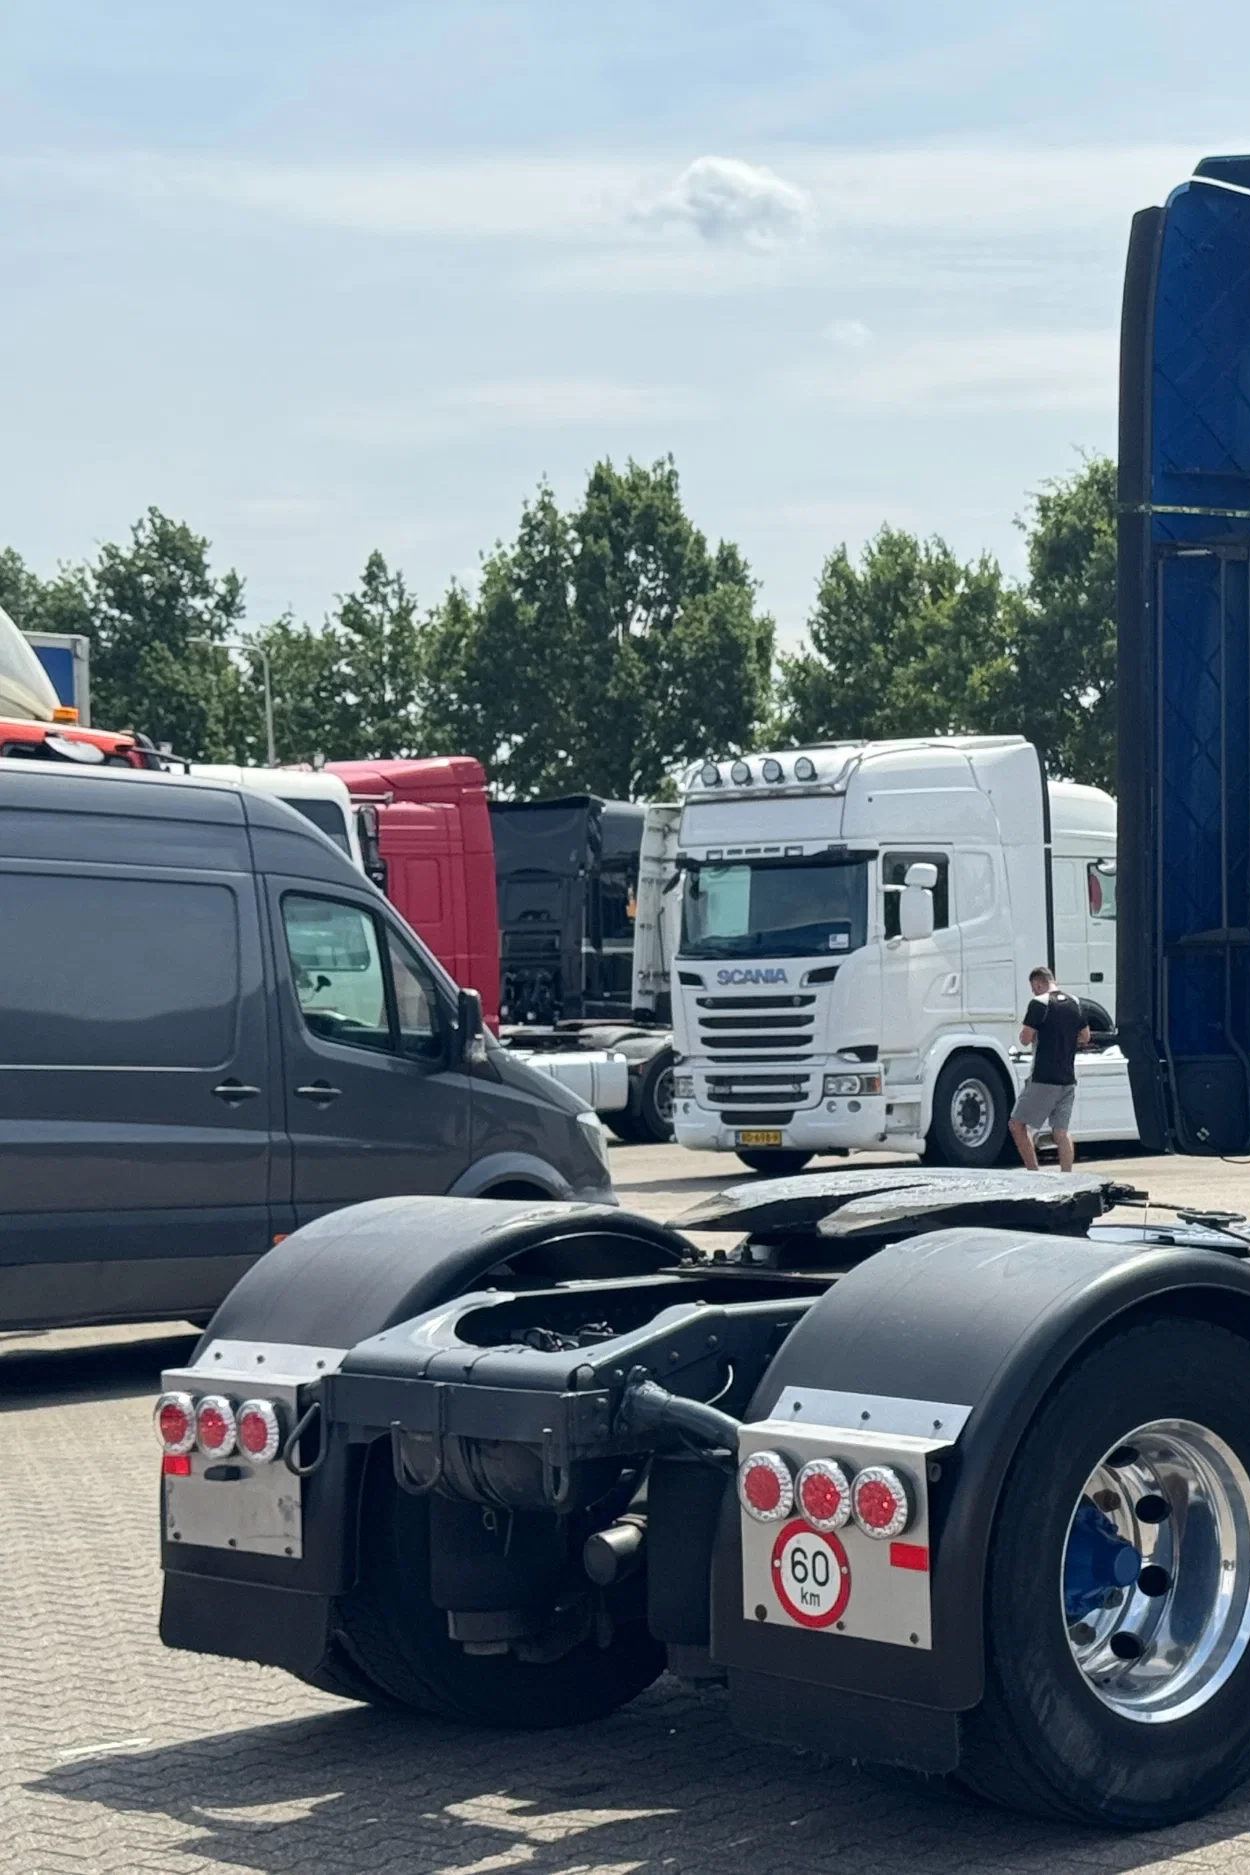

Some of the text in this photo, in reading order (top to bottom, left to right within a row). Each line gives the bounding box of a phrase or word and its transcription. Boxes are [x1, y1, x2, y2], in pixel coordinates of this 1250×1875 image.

[717, 968, 788, 985] SCANIA
[791, 1547, 829, 1587] 60
[801, 1587, 821, 1607] km
